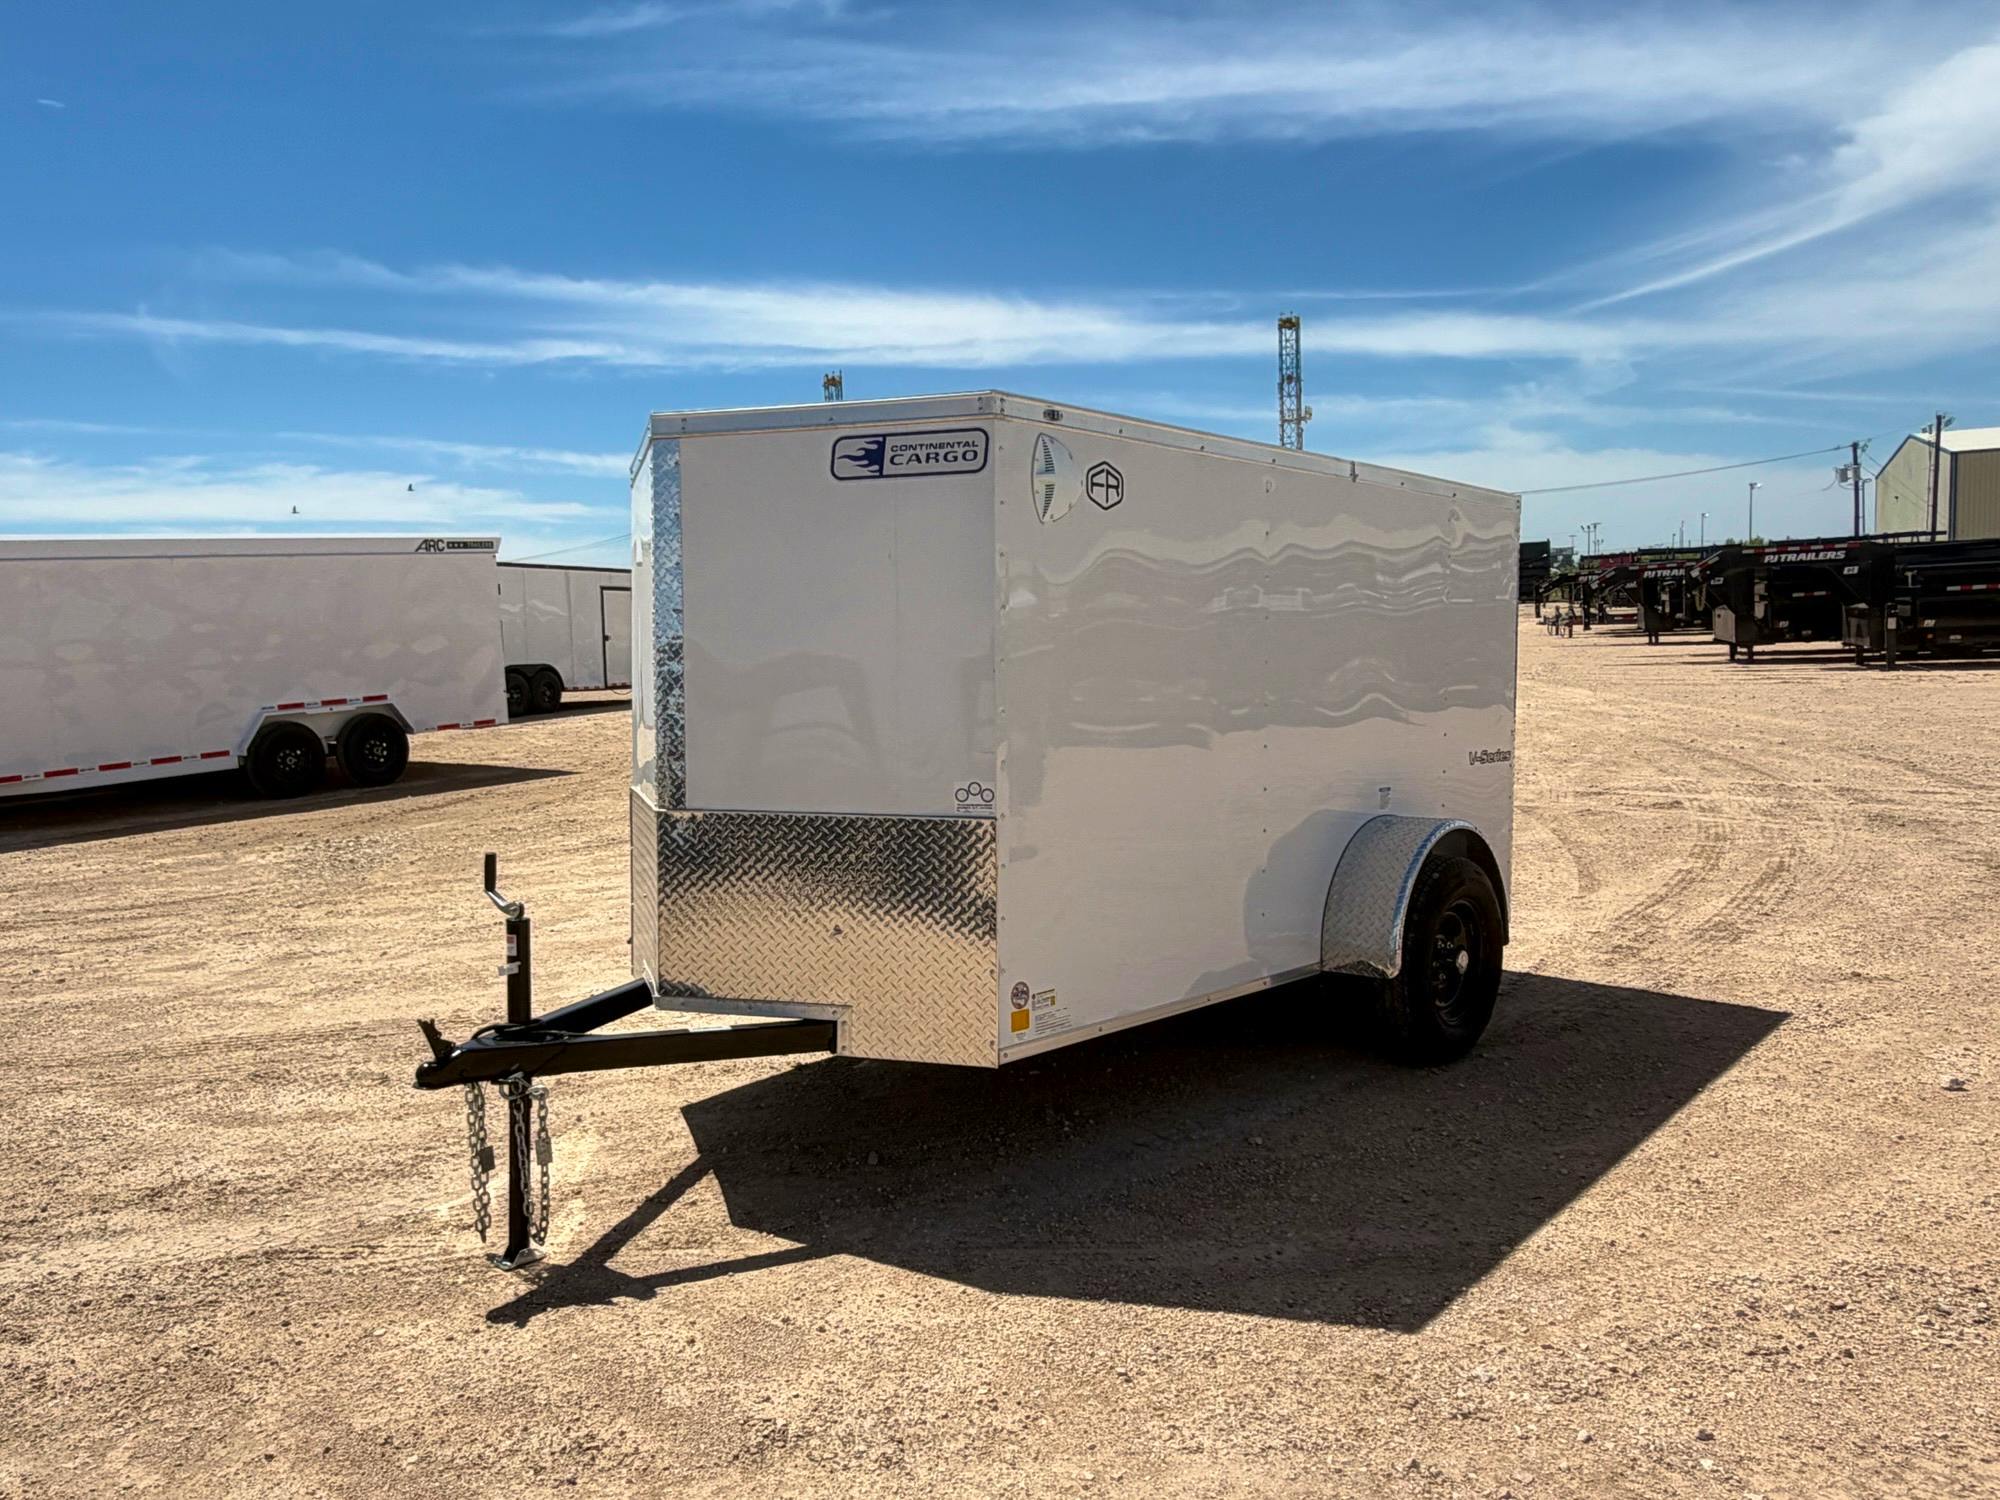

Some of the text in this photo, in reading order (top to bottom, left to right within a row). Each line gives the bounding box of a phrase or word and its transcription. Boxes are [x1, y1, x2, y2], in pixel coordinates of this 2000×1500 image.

[890, 440, 979, 453] CONTINENTAL
[889, 449, 979, 466] CARGO
[414, 539, 446, 552] ARC
[1763, 550, 1846, 564] PJ TRAILERS
[1468, 748, 1511, 765] V-Series
